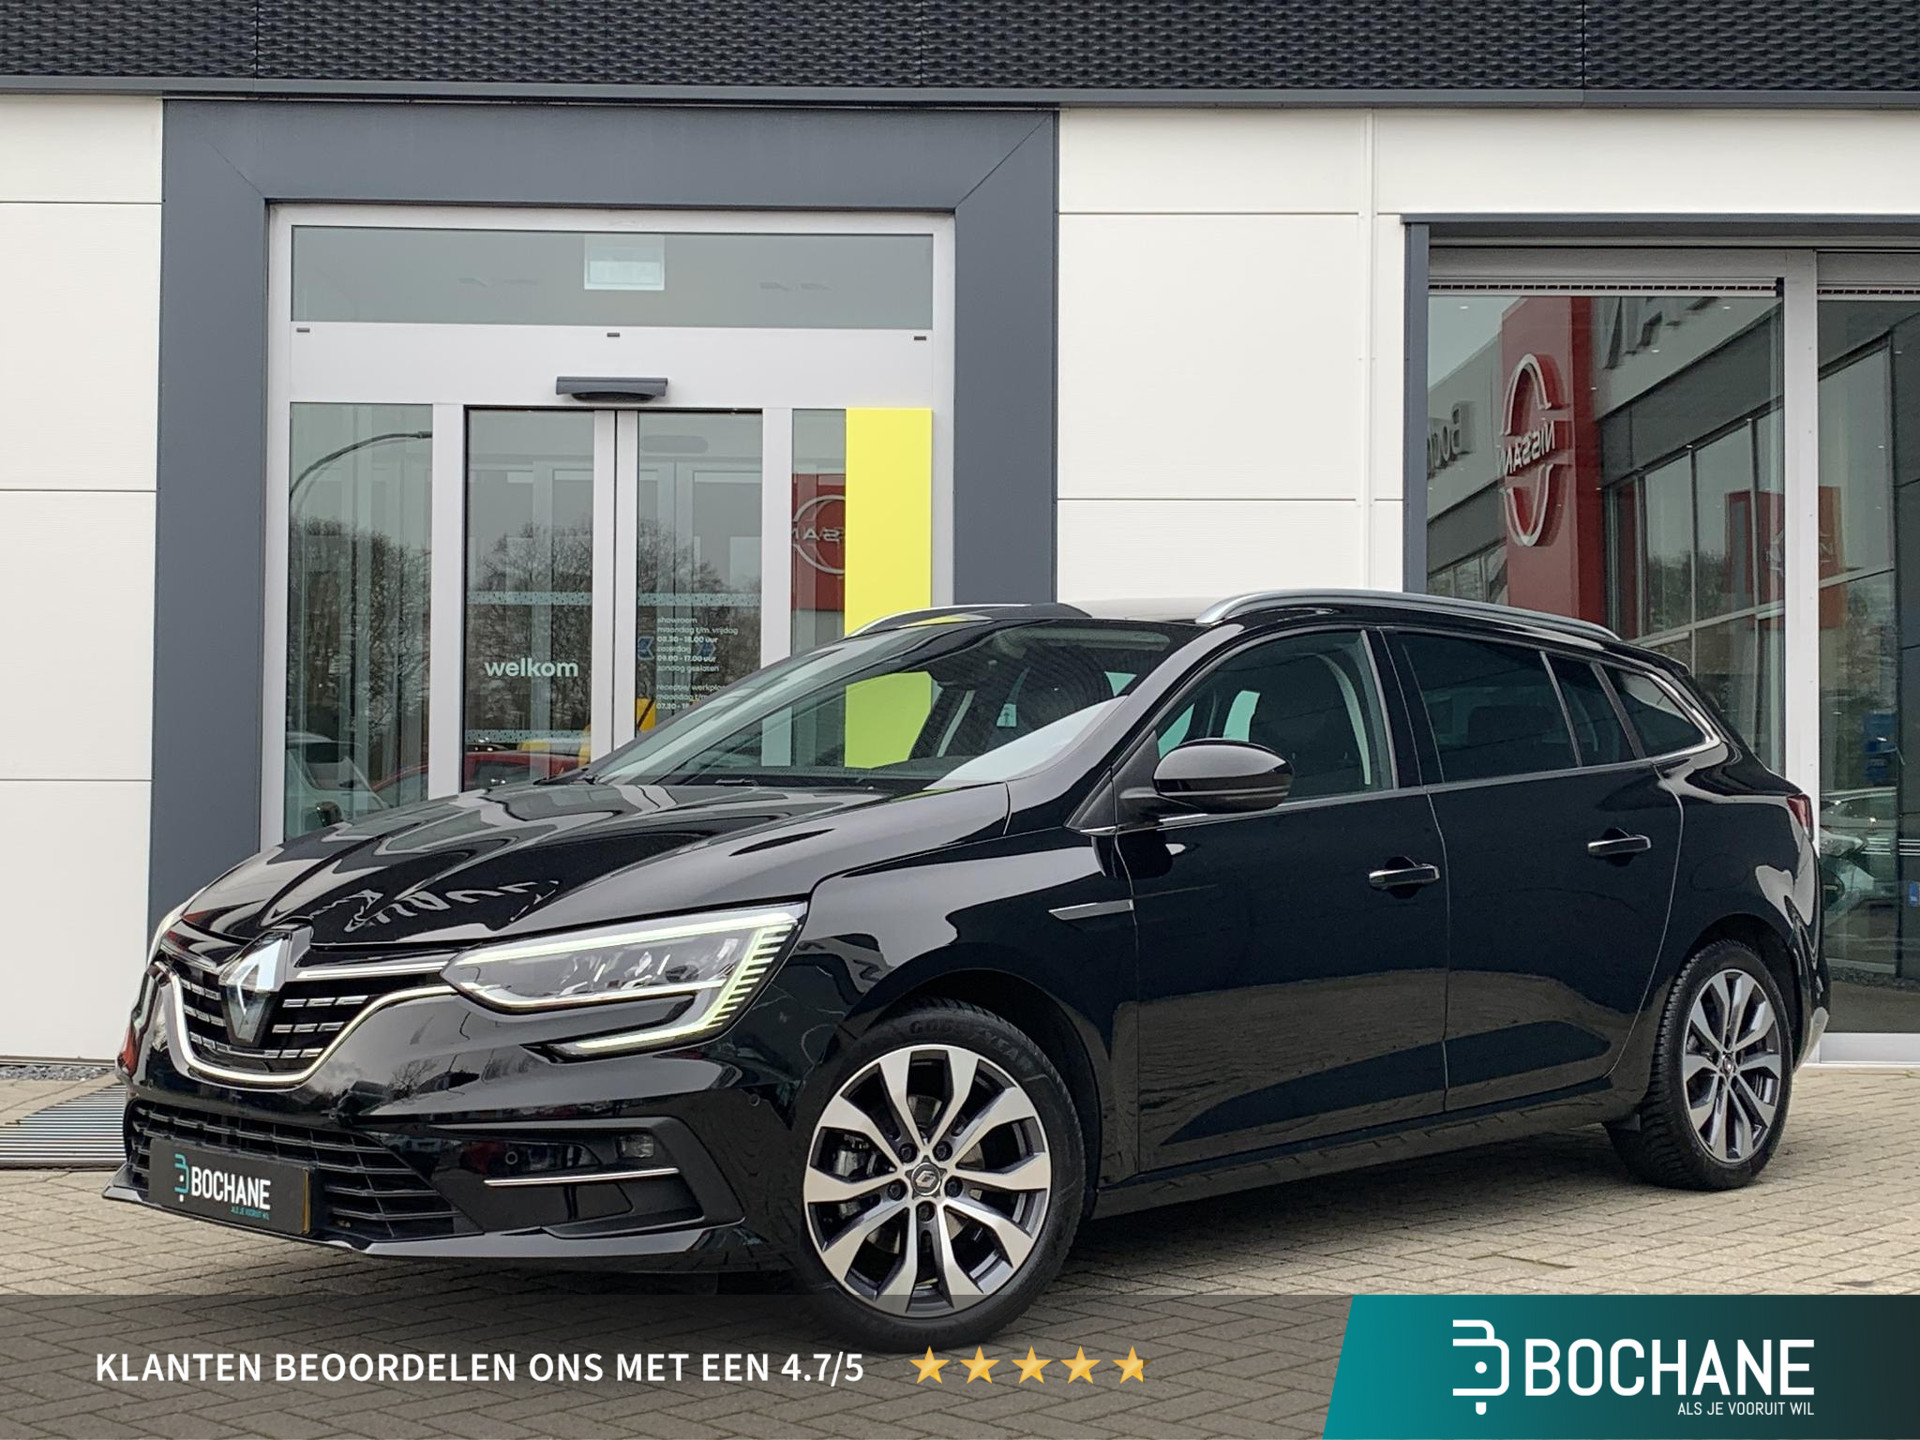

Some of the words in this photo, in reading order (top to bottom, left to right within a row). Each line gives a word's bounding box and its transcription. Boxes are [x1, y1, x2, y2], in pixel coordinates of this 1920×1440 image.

[712, 626, 739, 635] vrijdag
[484, 657, 579, 677] welkom
[190, 1166, 271, 1210] BOCHANE
